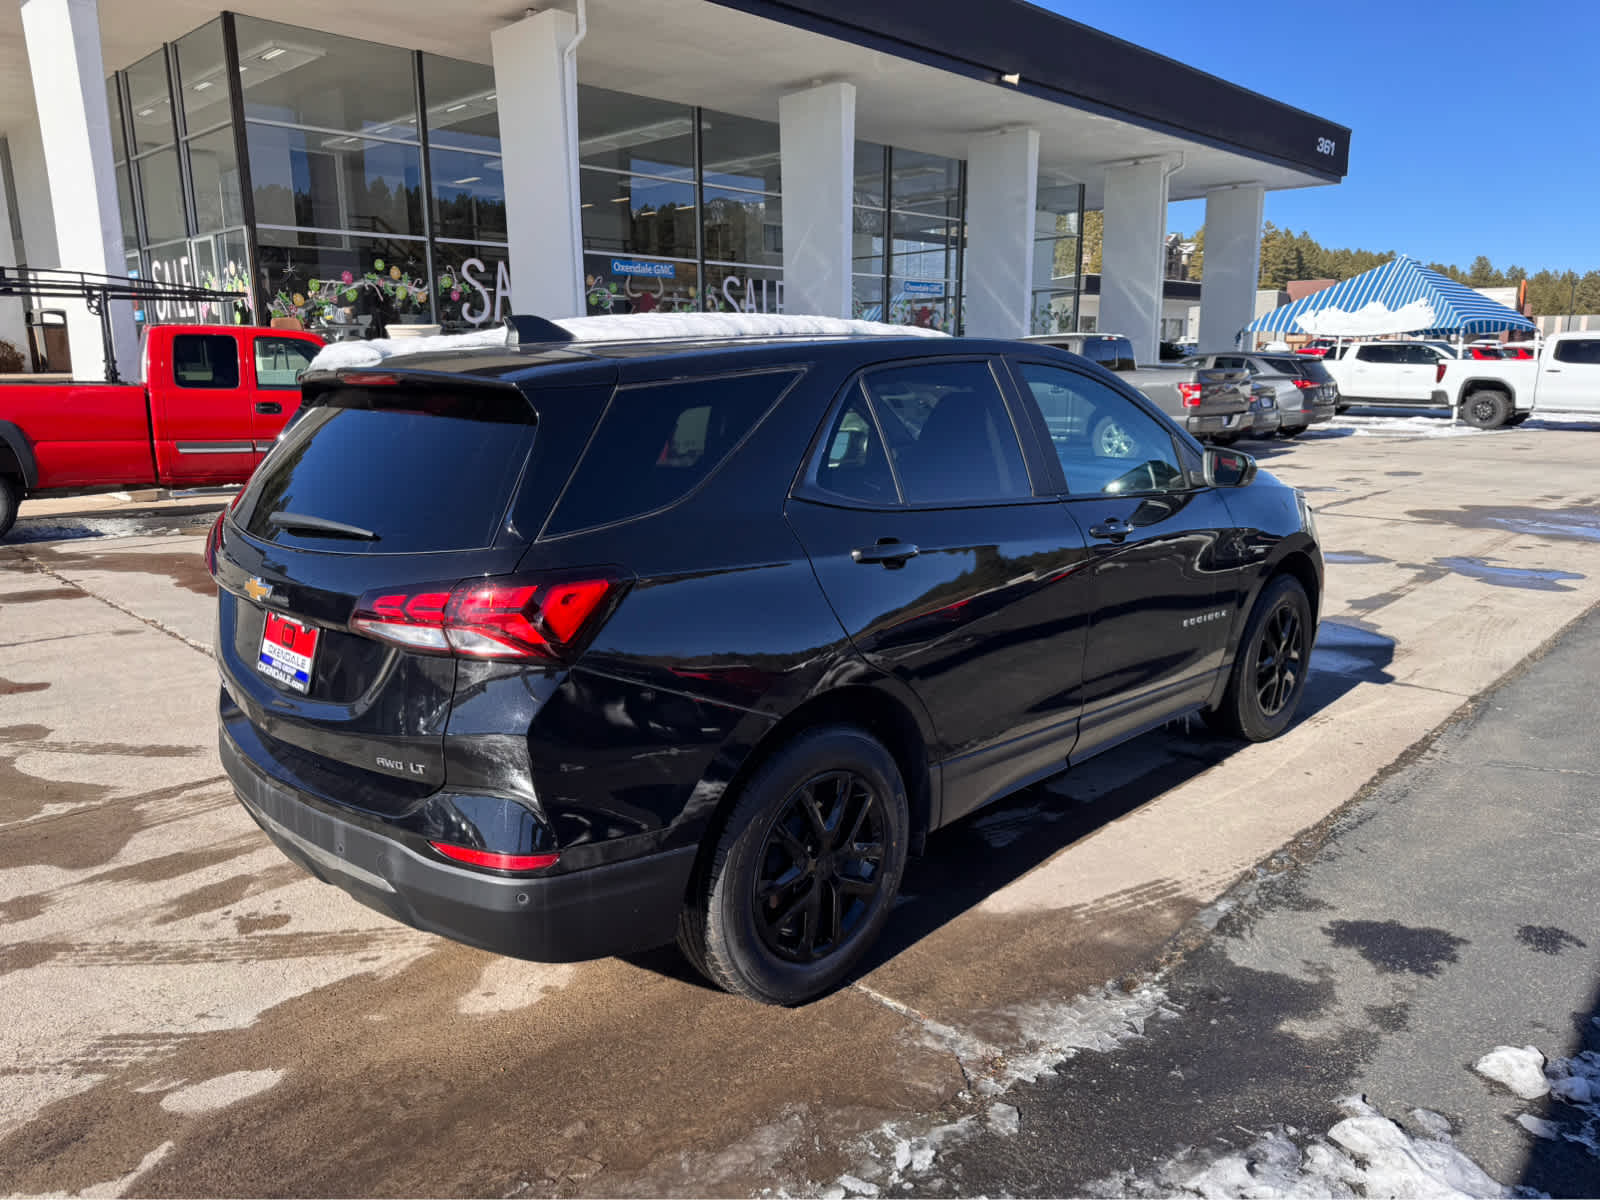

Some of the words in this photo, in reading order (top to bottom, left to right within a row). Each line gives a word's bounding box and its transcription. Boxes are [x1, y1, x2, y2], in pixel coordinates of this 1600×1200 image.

[1316, 136, 1335, 156] 361
[613, 261, 653, 275] Oxendale
[654, 263, 673, 275] GMC
[152, 256, 195, 320] SALE
[376, 756, 403, 770] AWD
[410, 762, 425, 775] LT
